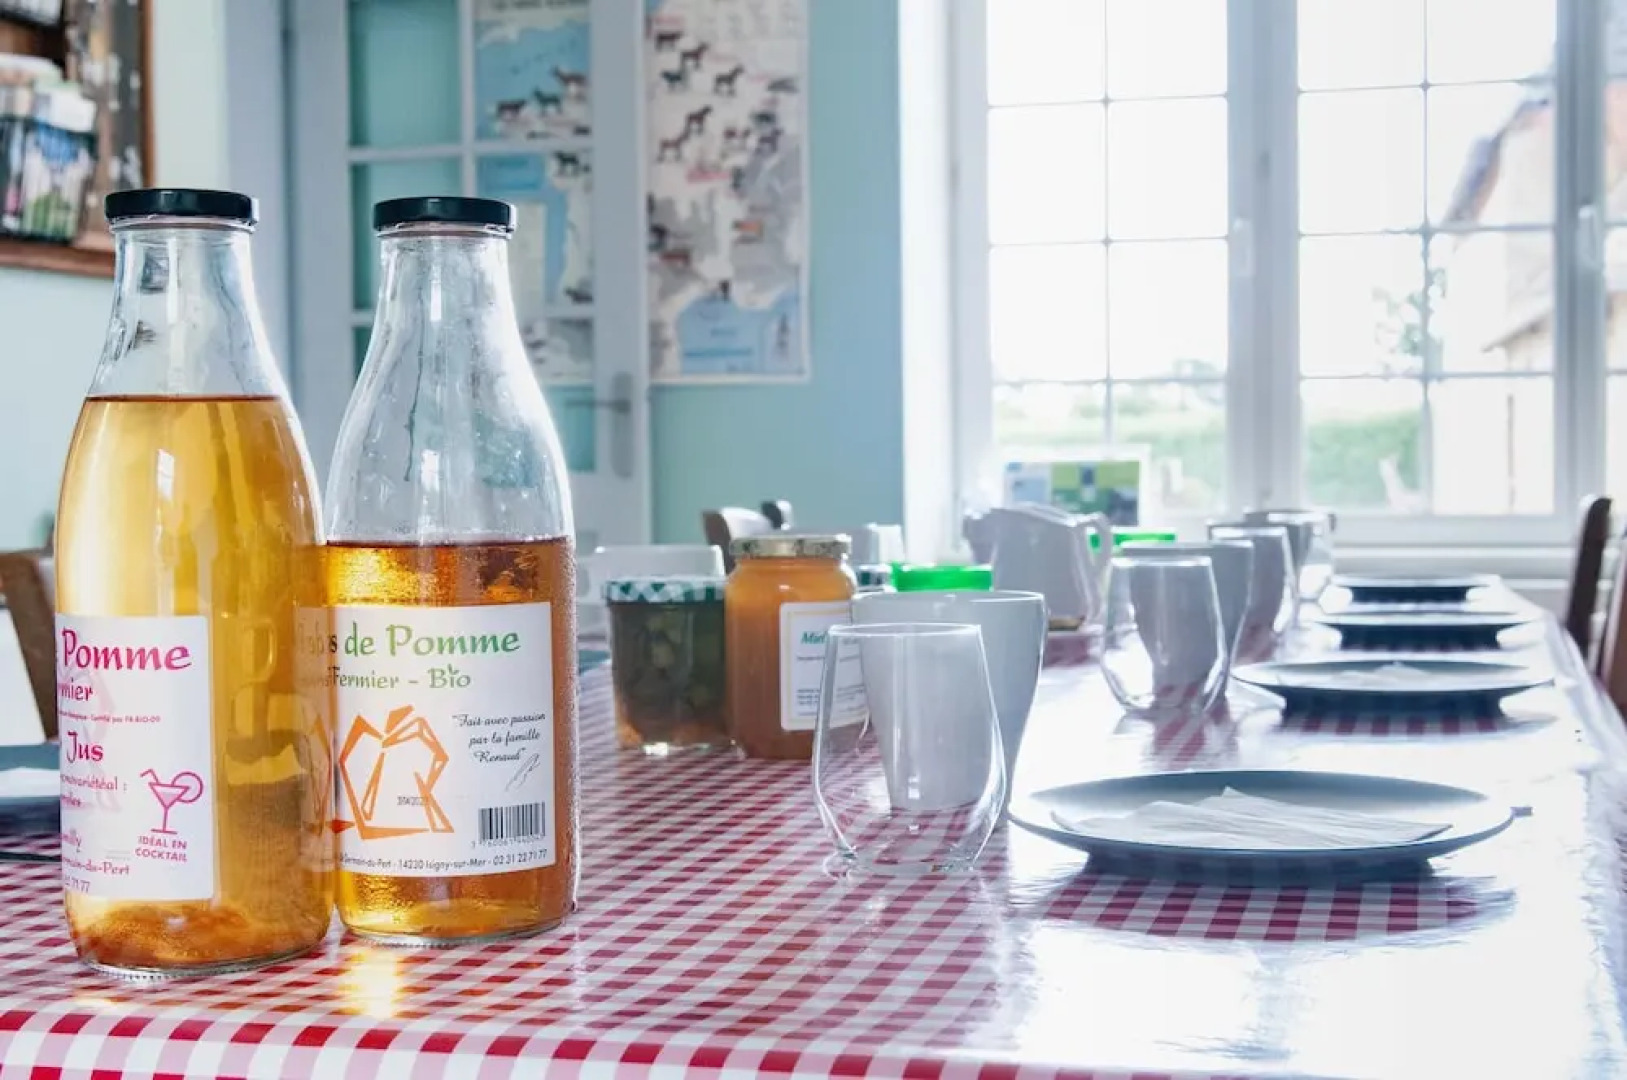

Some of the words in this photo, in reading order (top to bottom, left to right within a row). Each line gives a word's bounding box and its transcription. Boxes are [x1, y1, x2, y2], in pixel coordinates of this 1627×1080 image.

[62, 627, 192, 671] Pomme
[345, 621, 375, 657] de
[385, 624, 520, 657] Pomme
[427, 663, 471, 689] Bio
[67, 731, 103, 763] Jus
[135, 847, 187, 862] COCKTAIL
